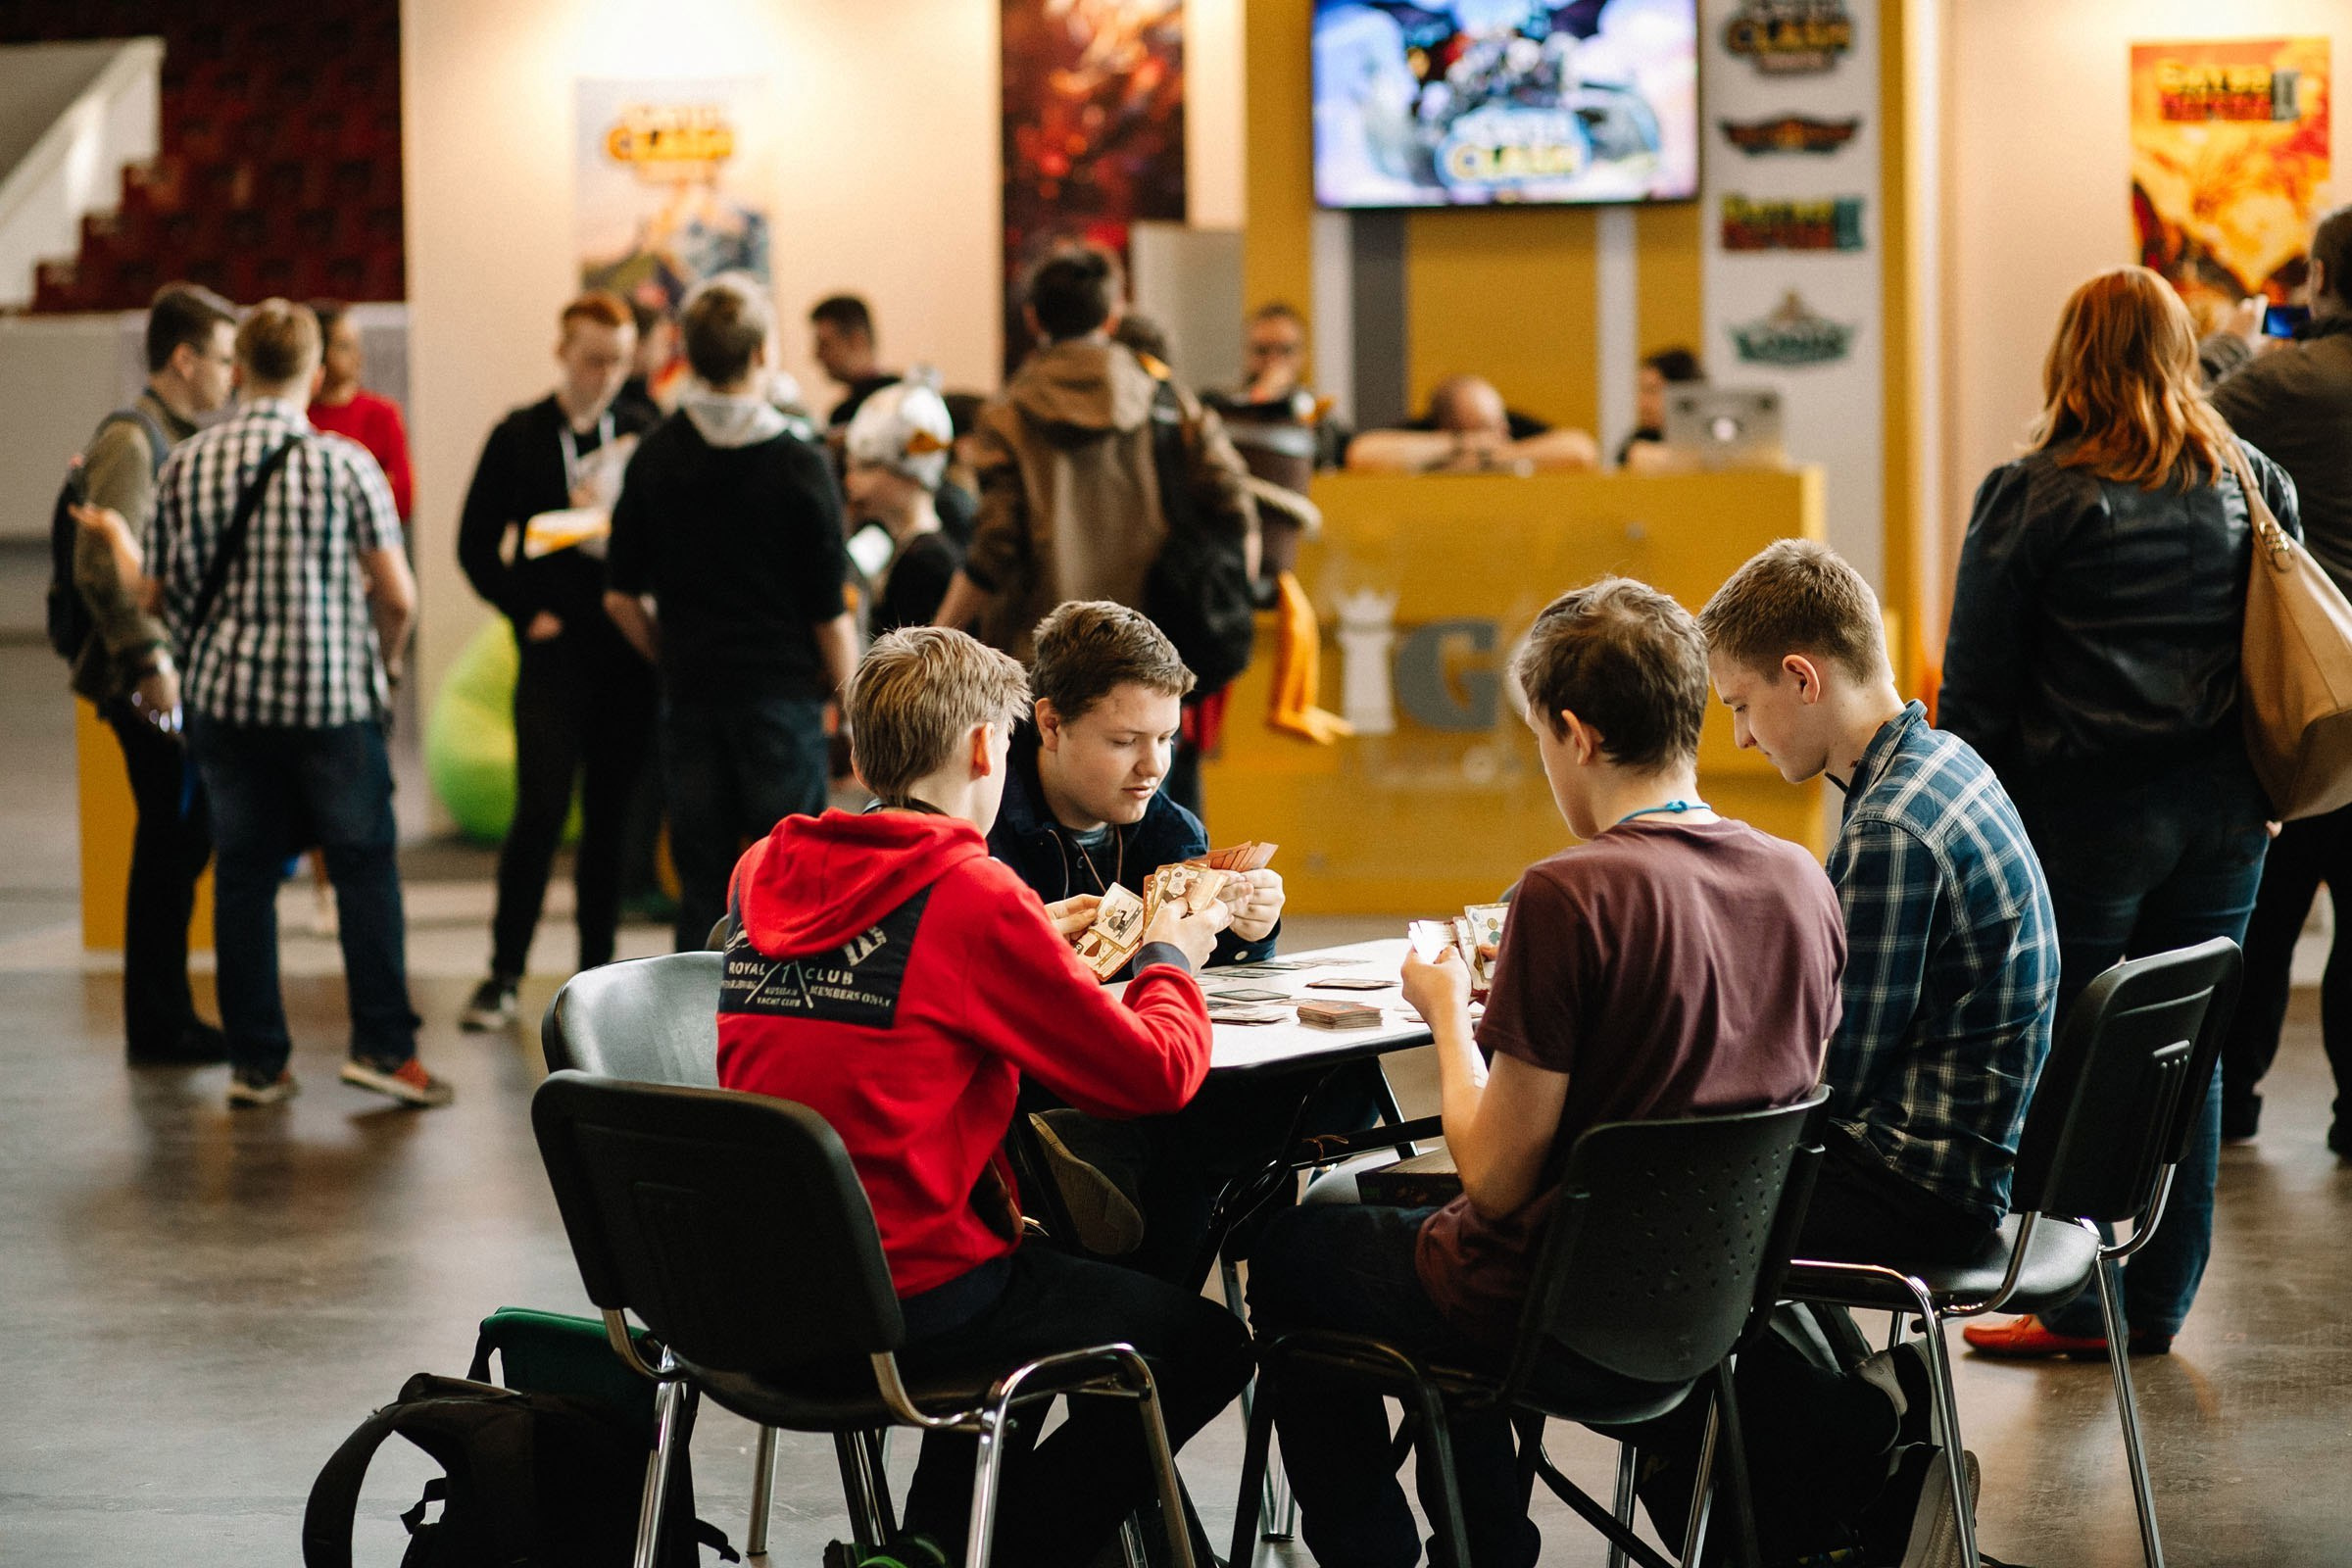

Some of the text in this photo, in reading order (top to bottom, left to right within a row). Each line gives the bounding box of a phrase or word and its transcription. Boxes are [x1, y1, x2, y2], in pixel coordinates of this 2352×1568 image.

[728, 961, 854, 986] ROYAL CLUB
[809, 985, 861, 1002] MEMBERS
